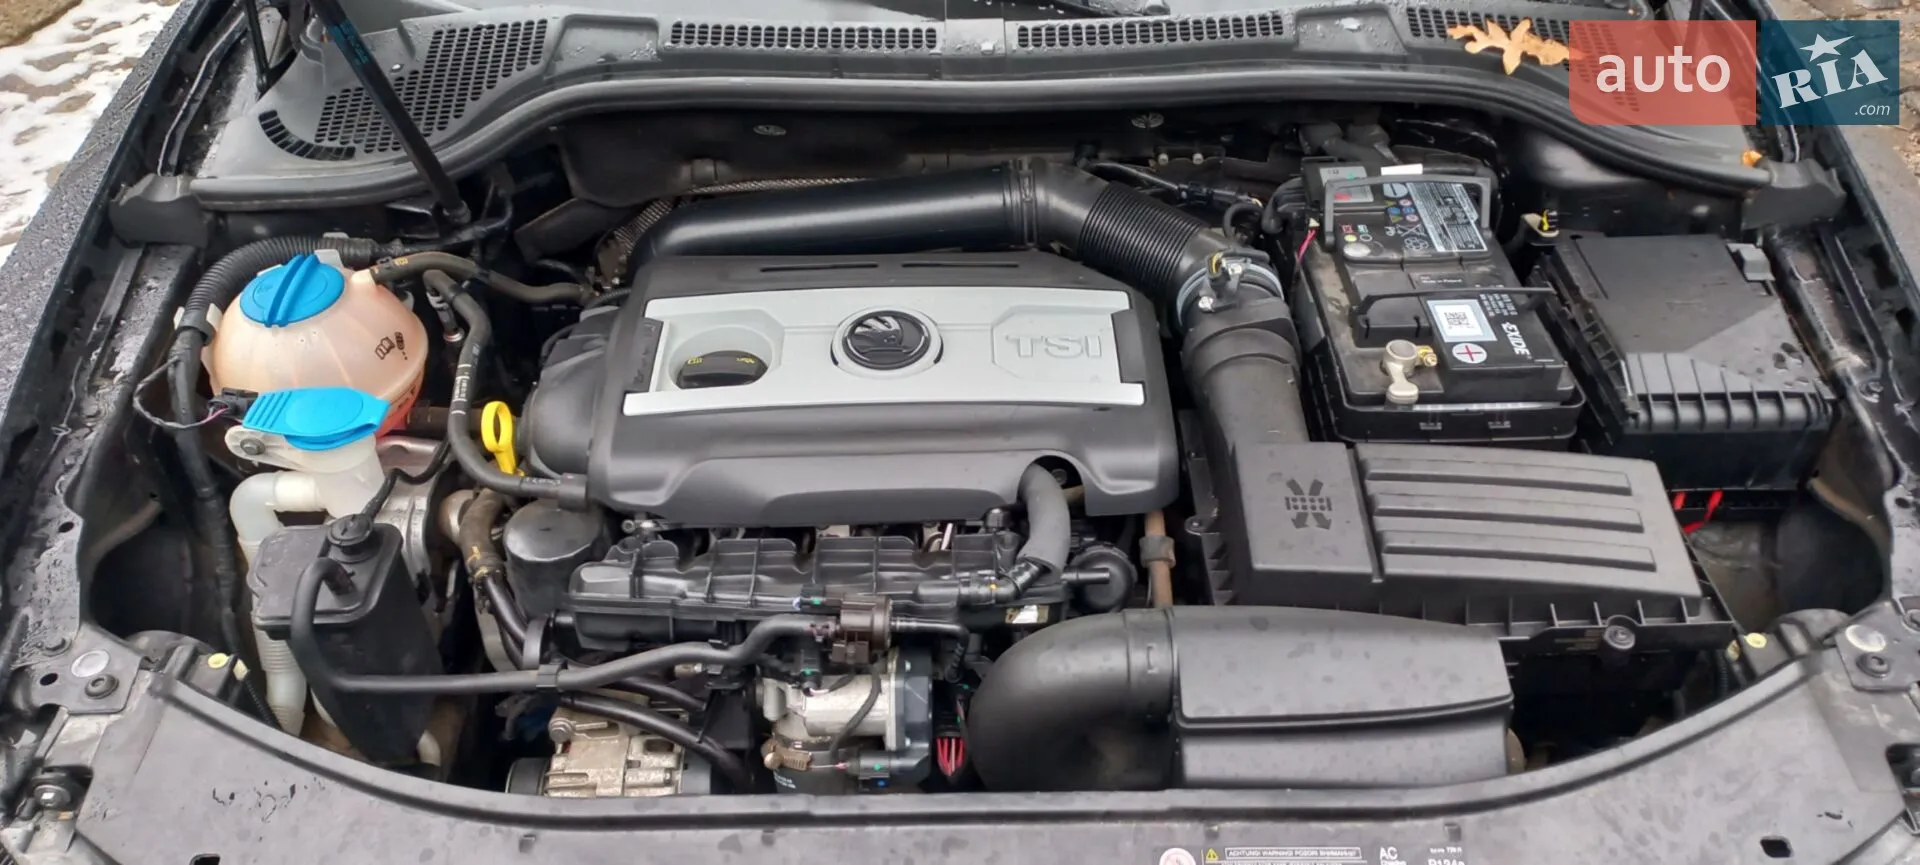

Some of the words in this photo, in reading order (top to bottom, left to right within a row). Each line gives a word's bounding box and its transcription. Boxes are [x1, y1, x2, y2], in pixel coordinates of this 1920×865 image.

[1005, 335, 1102, 359] TSI
[1501, 321, 1531, 357] EXIDE
[1379, 847, 1398, 860] AC
